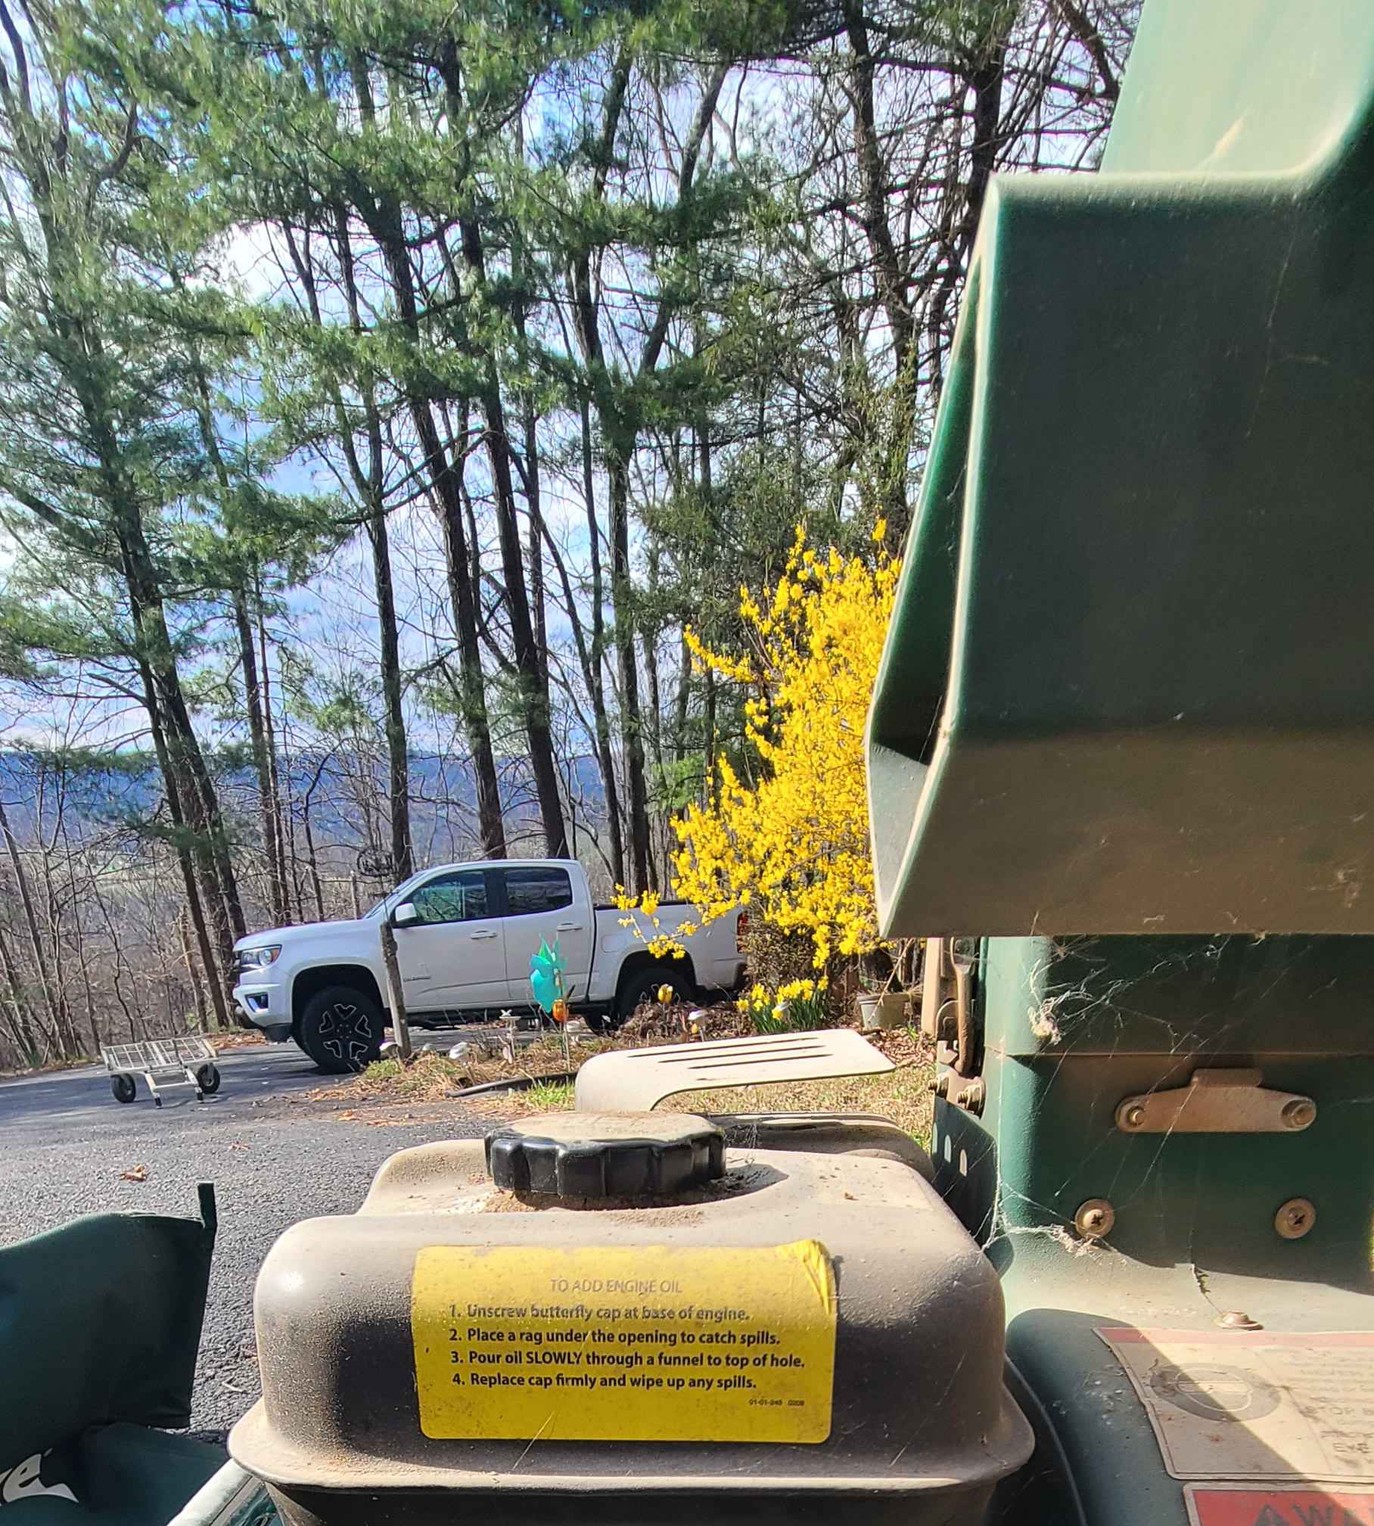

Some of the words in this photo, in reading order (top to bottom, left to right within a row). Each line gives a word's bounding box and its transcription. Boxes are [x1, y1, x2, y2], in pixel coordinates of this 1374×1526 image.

[551, 1279, 569, 1293] TO
[572, 1279, 603, 1293] ADD
[606, 1279, 656, 1294] ENGINE
[660, 1280, 683, 1294] OIL
[449, 1304, 462, 1318] 1.
[467, 1304, 527, 1318] Unscrew
[531, 1304, 592, 1322] butterfly
[597, 1308, 621, 1322] cap
[624, 1308, 638, 1319] at
[642, 1306, 675, 1320] base
[679, 1306, 695, 1320] of
[696, 1308, 749, 1323] engine.
[449, 1328, 462, 1341] 2.
[468, 1328, 504, 1342] Place
[508, 1332, 516, 1342] a
[520, 1331, 543, 1345] rag
[547, 1329, 587, 1342] under
[592, 1330, 614, 1343] the
[618, 1331, 677, 1346] opening
[681, 1332, 696, 1344] to
[699, 1331, 736, 1344] catch
[740, 1332, 780, 1347] spills.
[451, 1351, 463, 1364] 3.
[469, 1351, 501, 1364] Pour
[505, 1351, 522, 1364] oil
[526, 1351, 582, 1365] SLOWLY
[586, 1352, 643, 1368] through
[646, 1355, 654, 1365] a
[657, 1352, 703, 1366] funnel
[707, 1354, 722, 1367] to
[725, 1354, 749, 1369] top
[753, 1353, 768, 1367] of
[770, 1354, 805, 1368] hole.
[452, 1373, 465, 1385] 4.
[471, 1373, 525, 1388] Replace
[528, 1377, 552, 1389] cap
[556, 1374, 597, 1389] firmly
[600, 1374, 626, 1387] and
[630, 1375, 663, 1390] wipe
[667, 1378, 685, 1390] up
[688, 1378, 714, 1391] any
[717, 1375, 757, 1390] spills.
